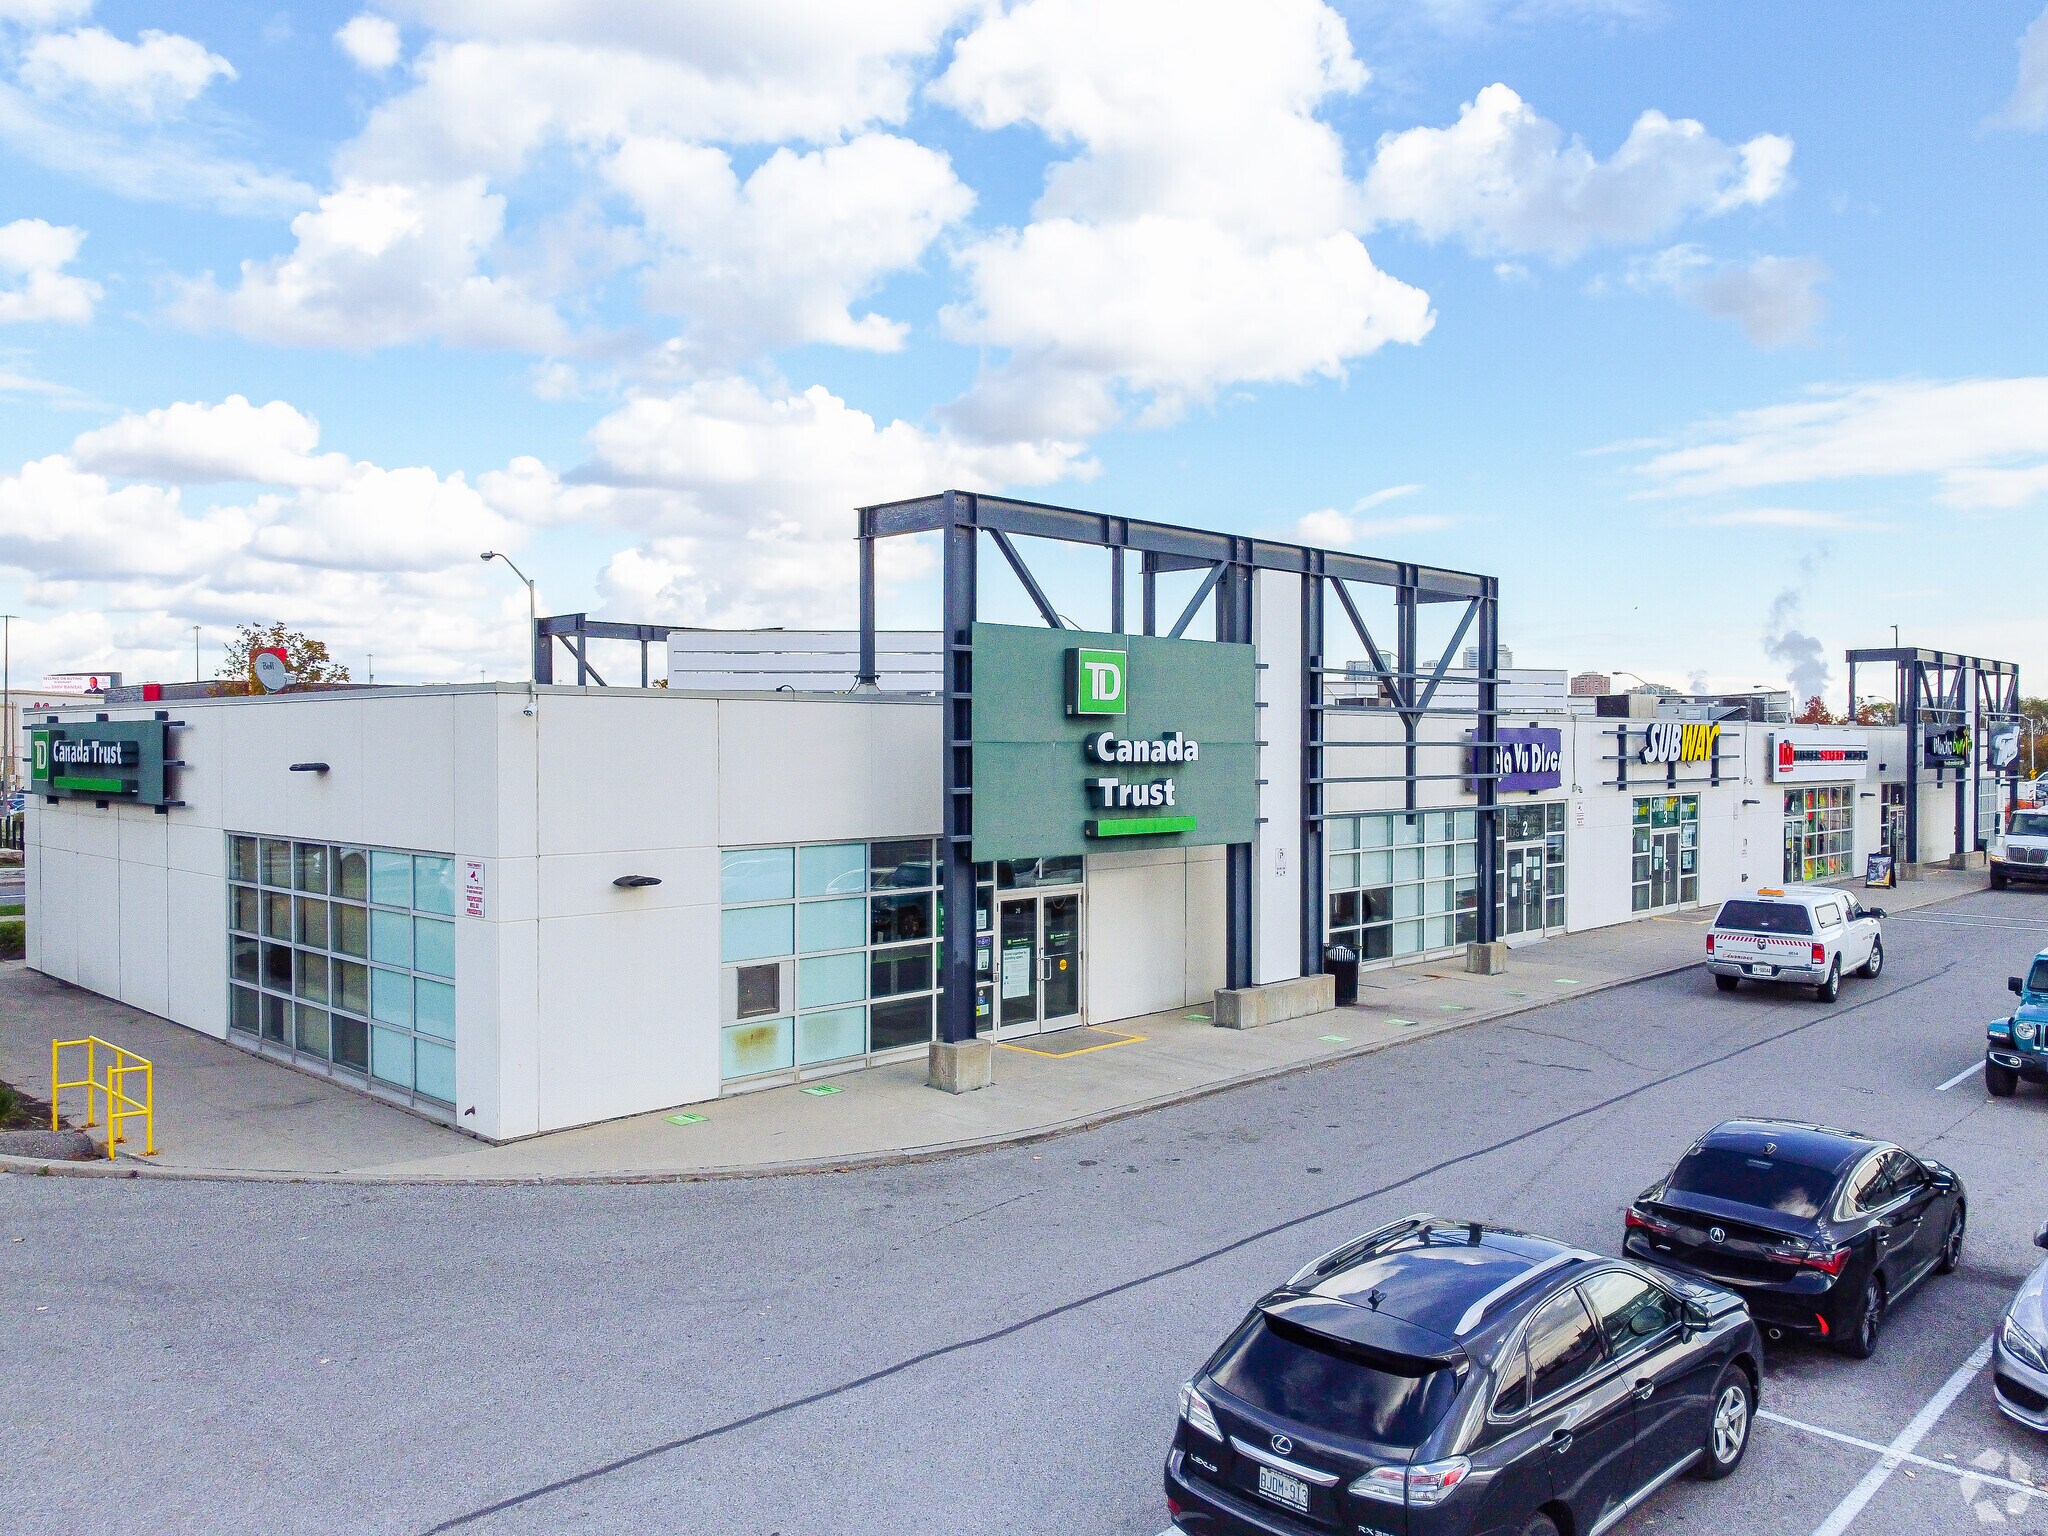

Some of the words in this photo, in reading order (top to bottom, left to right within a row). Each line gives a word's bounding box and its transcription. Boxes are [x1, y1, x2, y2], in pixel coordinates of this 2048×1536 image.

[262, 661, 275, 671] Bell
[1084, 662, 1121, 701] TD
[34, 740, 47, 770] TD
[53, 739, 89, 763] Canada
[91, 740, 122, 764] Trust
[1096, 731, 1199, 763] Canada
[1513, 743, 1529, 773] Vu
[1644, 723, 1721, 763] SUBWAY
[1099, 777, 1175, 807] Trust
[1522, 820, 1528, 836] 2
[1663, 810, 1668, 824] 3
[1035, 857, 1043, 879] 1
[1190, 1453, 1218, 1473] LEXUS
